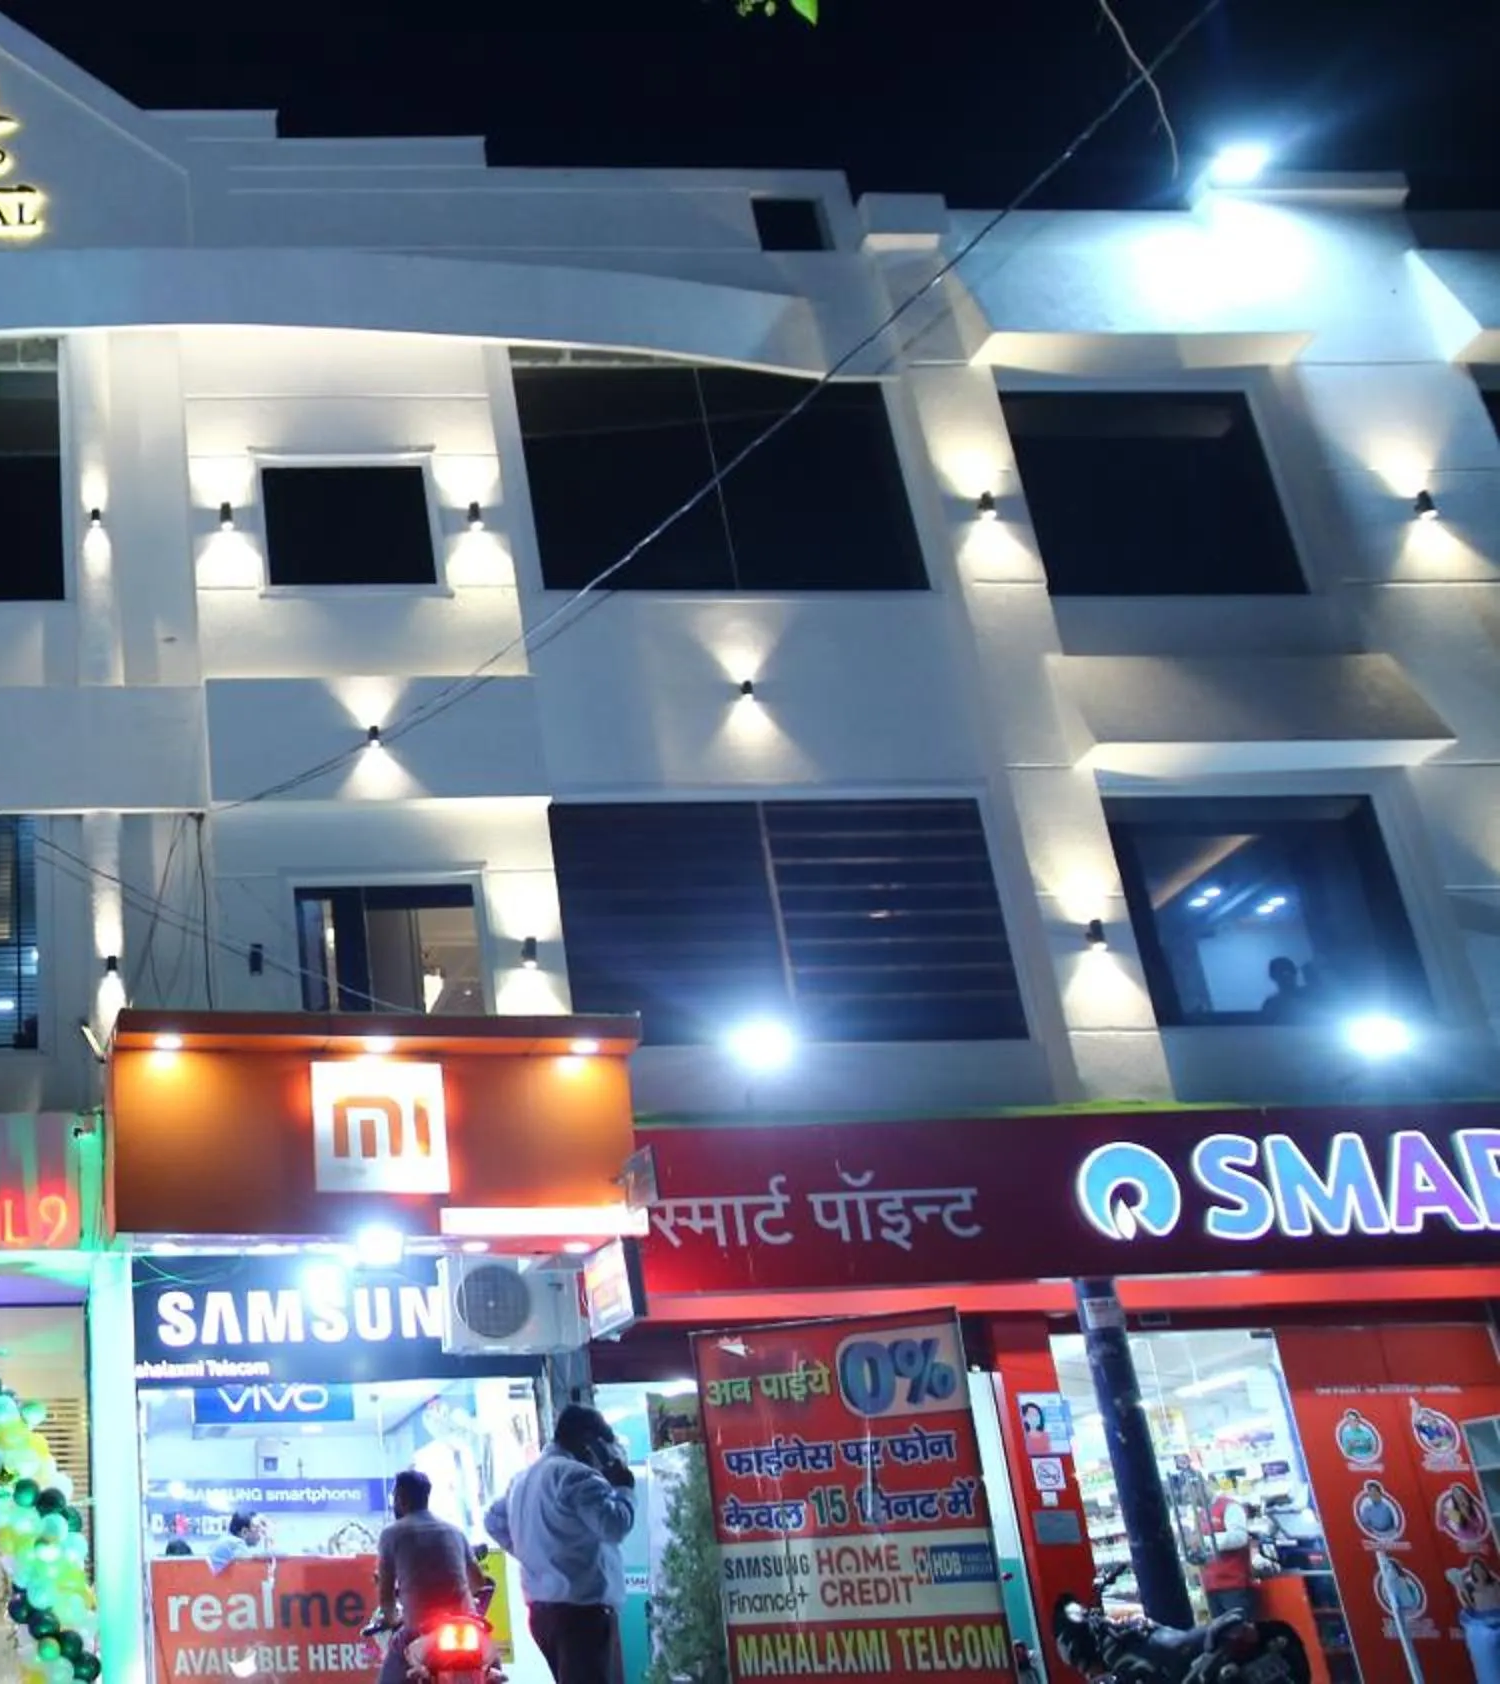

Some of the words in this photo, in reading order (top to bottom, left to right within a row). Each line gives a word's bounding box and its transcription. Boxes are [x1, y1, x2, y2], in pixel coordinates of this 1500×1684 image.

[650, 1174, 794, 1249] स्मार्ट
[806, 1168, 983, 1251] पॉइन्ट
[157, 1285, 444, 1347] SAMSUN
[706, 1374, 753, 1407] अब
[839, 1337, 957, 1417] 0%
[888, 1424, 956, 1465] फोन
[265, 1484, 362, 1504] smartphone
[723, 1493, 807, 1533] केवल
[809, 1485, 848, 1527] 15
[943, 1479, 976, 1518] में
[724, 1553, 810, 1581] SAMSUNG
[815, 1544, 902, 1576] HOME
[166, 1578, 366, 1633] realme
[819, 1575, 914, 1609] CREDIT
[307, 1642, 368, 1672] HERE
[736, 1630, 892, 1678] MAHALAXMI
[900, 1624, 1010, 1671] TELCOM
